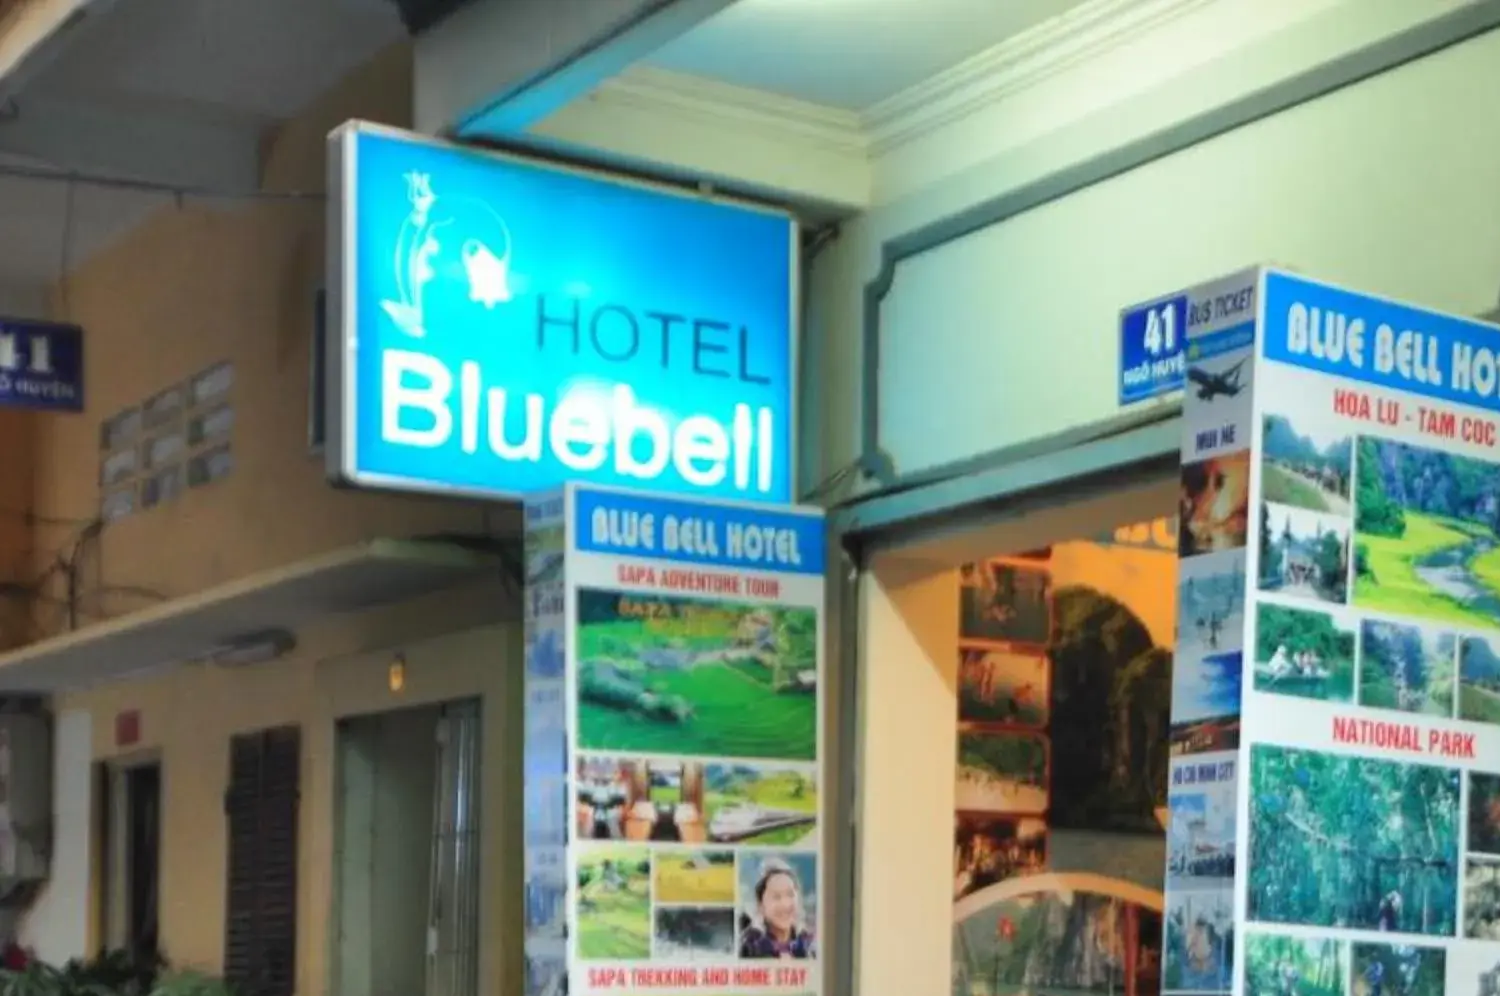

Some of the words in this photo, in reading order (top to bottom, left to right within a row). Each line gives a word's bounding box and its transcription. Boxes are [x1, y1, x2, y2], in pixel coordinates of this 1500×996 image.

[534, 293, 771, 387] HOTEL
[1143, 303, 1176, 356] 41
[1287, 302, 1364, 369] BLUE
[1374, 324, 1442, 387] BELL
[381, 349, 775, 493] Bluebell
[1333, 389, 1370, 420] HOA
[1378, 397, 1399, 426] LU
[1419, 405, 1455, 438] TAM
[1461, 416, 1497, 447] COC
[591, 507, 655, 550] BLUE
[663, 515, 718, 557] BELL
[726, 522, 802, 565] HOTEL
[618, 564, 656, 588] SAPA
[660, 567, 741, 596] ADVENTURE
[745, 575, 780, 599] TOUR
[1332, 716, 1422, 752] NATIONAL
[1429, 724, 1476, 758] PARK
[588, 967, 626, 989] SAPA
[703, 967, 729, 986] AND
[733, 966, 770, 986] HOME
[775, 966, 808, 986] STAY
